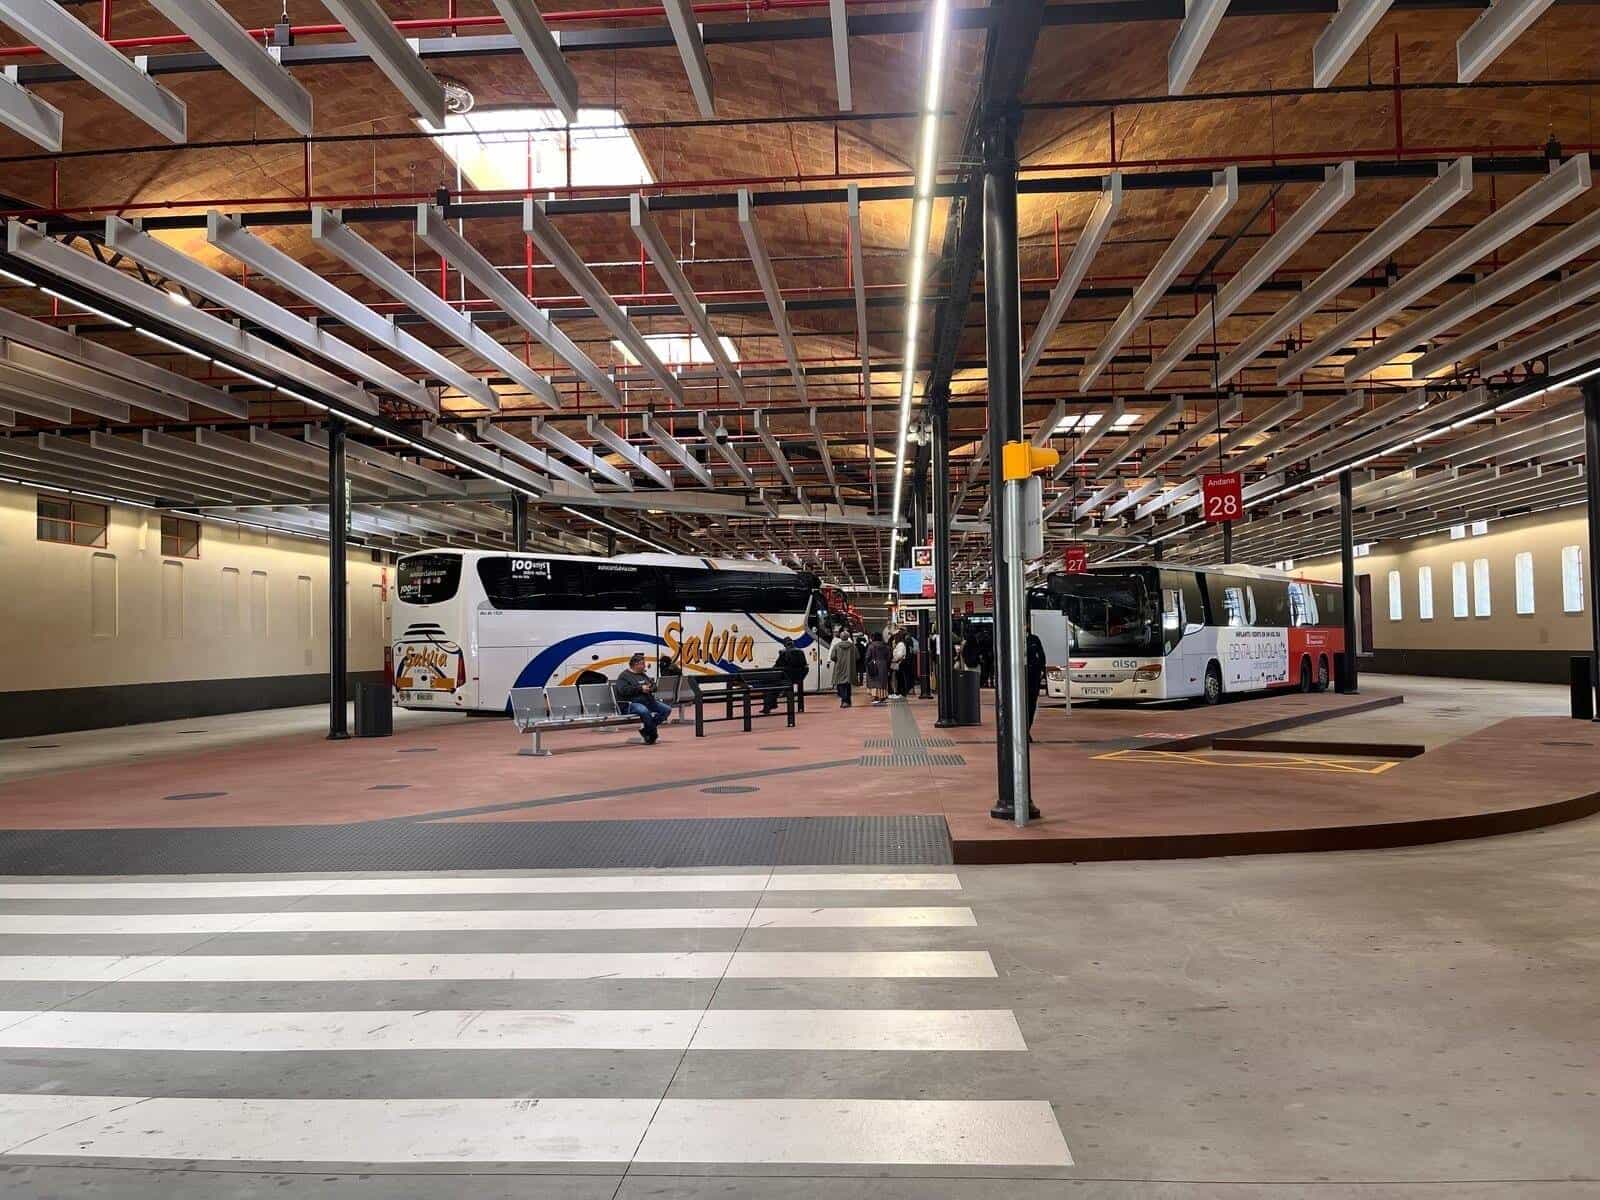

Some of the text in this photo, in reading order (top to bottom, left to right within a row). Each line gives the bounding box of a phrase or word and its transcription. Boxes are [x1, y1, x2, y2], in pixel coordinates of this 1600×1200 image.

[1210, 495, 1237, 516] 28
[512, 560, 533, 572] 100
[1069, 560, 1083, 571] 27
[664, 621, 754, 664] Salvia
[405, 646, 448, 668] Salvia
[1112, 660, 1137, 669] alsa
